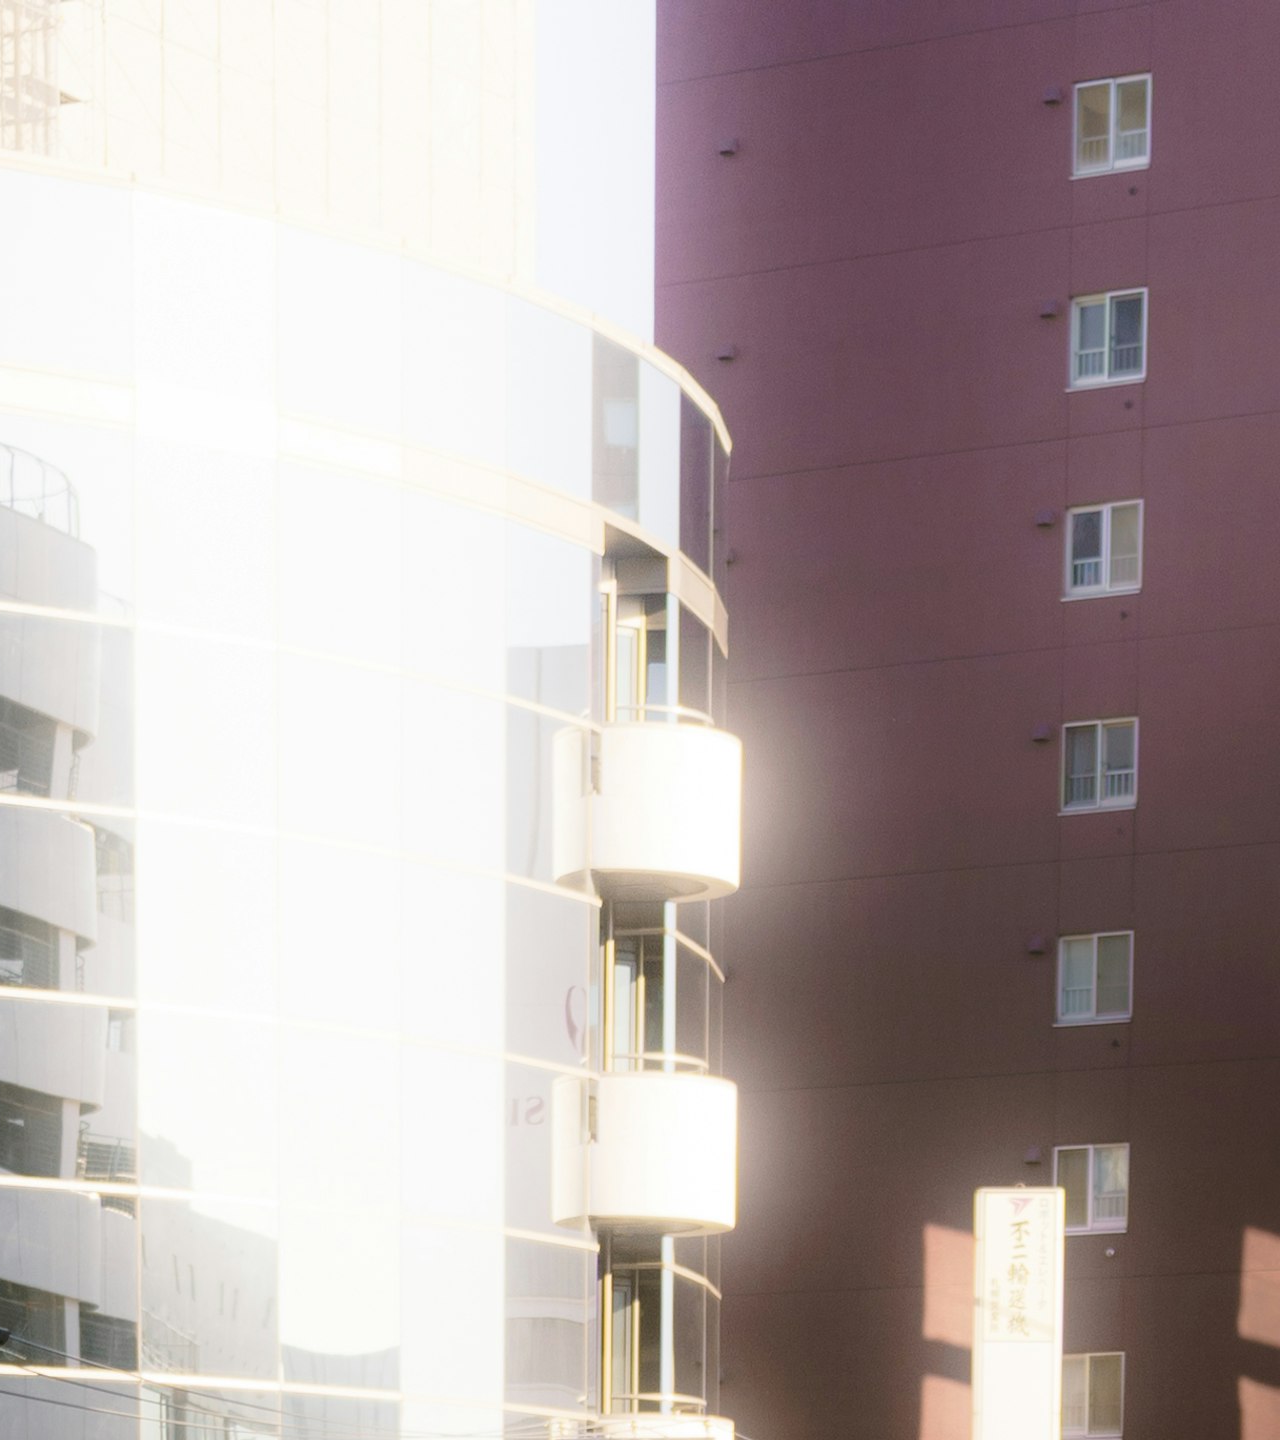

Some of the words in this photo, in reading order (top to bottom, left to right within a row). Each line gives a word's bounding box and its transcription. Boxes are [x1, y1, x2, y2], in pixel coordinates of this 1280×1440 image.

[1008, 1220, 1030, 1337] 不二輸送機
